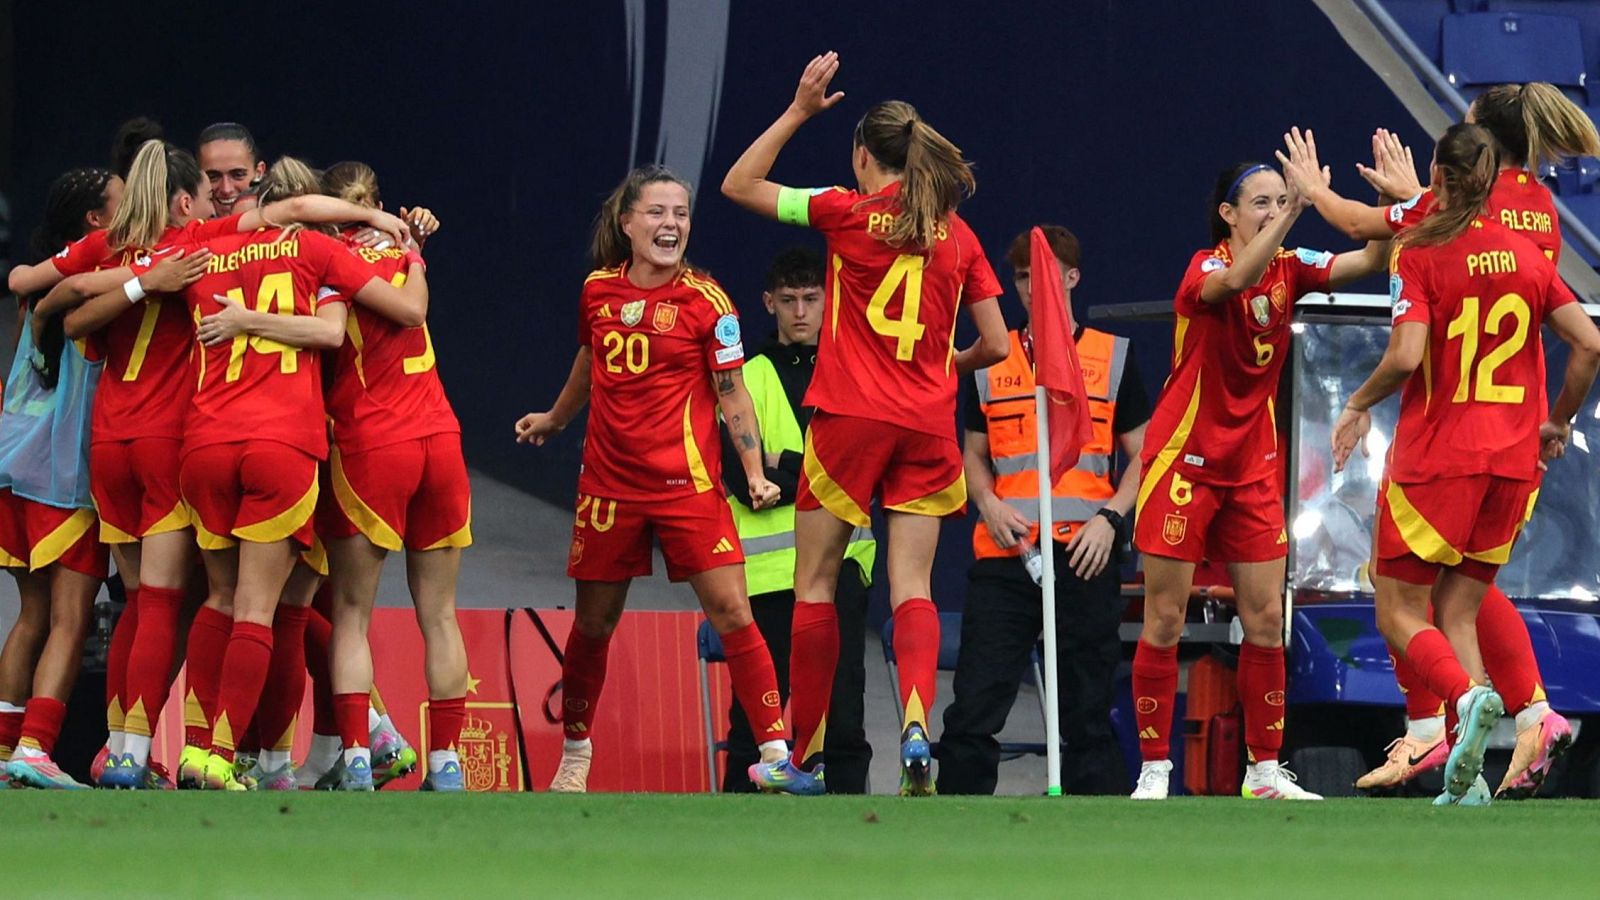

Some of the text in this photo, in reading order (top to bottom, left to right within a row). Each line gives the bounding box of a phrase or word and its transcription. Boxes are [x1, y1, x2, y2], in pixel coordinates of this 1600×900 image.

[1500, 208, 1552, 234] ALEXIA
[206, 239, 299, 274] ALEXANDRI
[1466, 250, 1517, 277] PATRI
[865, 254, 926, 362] 4
[225, 271, 303, 384] 14
[602, 330, 650, 375] 20
[1253, 330, 1274, 367] 6
[1447, 292, 1531, 404] 12
[995, 375, 1022, 388] 194
[1169, 471, 1193, 506] 6
